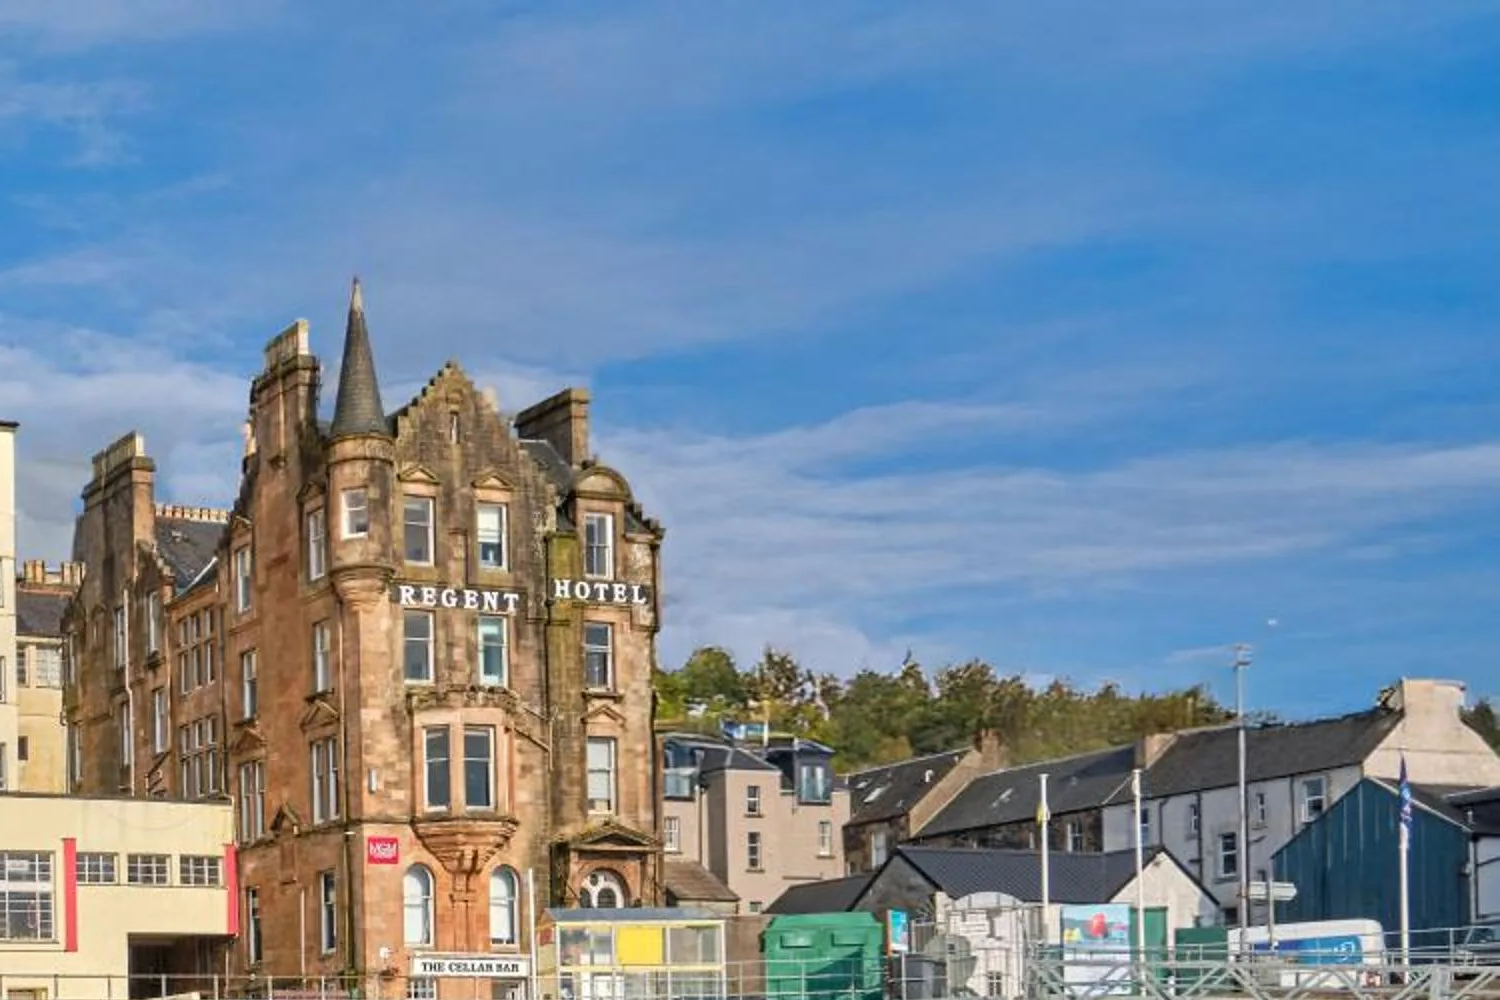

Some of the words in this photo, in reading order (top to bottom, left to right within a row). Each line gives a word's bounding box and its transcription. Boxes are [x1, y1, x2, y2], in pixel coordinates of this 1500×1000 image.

[399, 585, 518, 612] REGENT
[554, 579, 647, 604] HOTEL
[421, 961, 444, 973] THE
[448, 962, 494, 973] CELLAR
[496, 963, 519, 973] BAR
